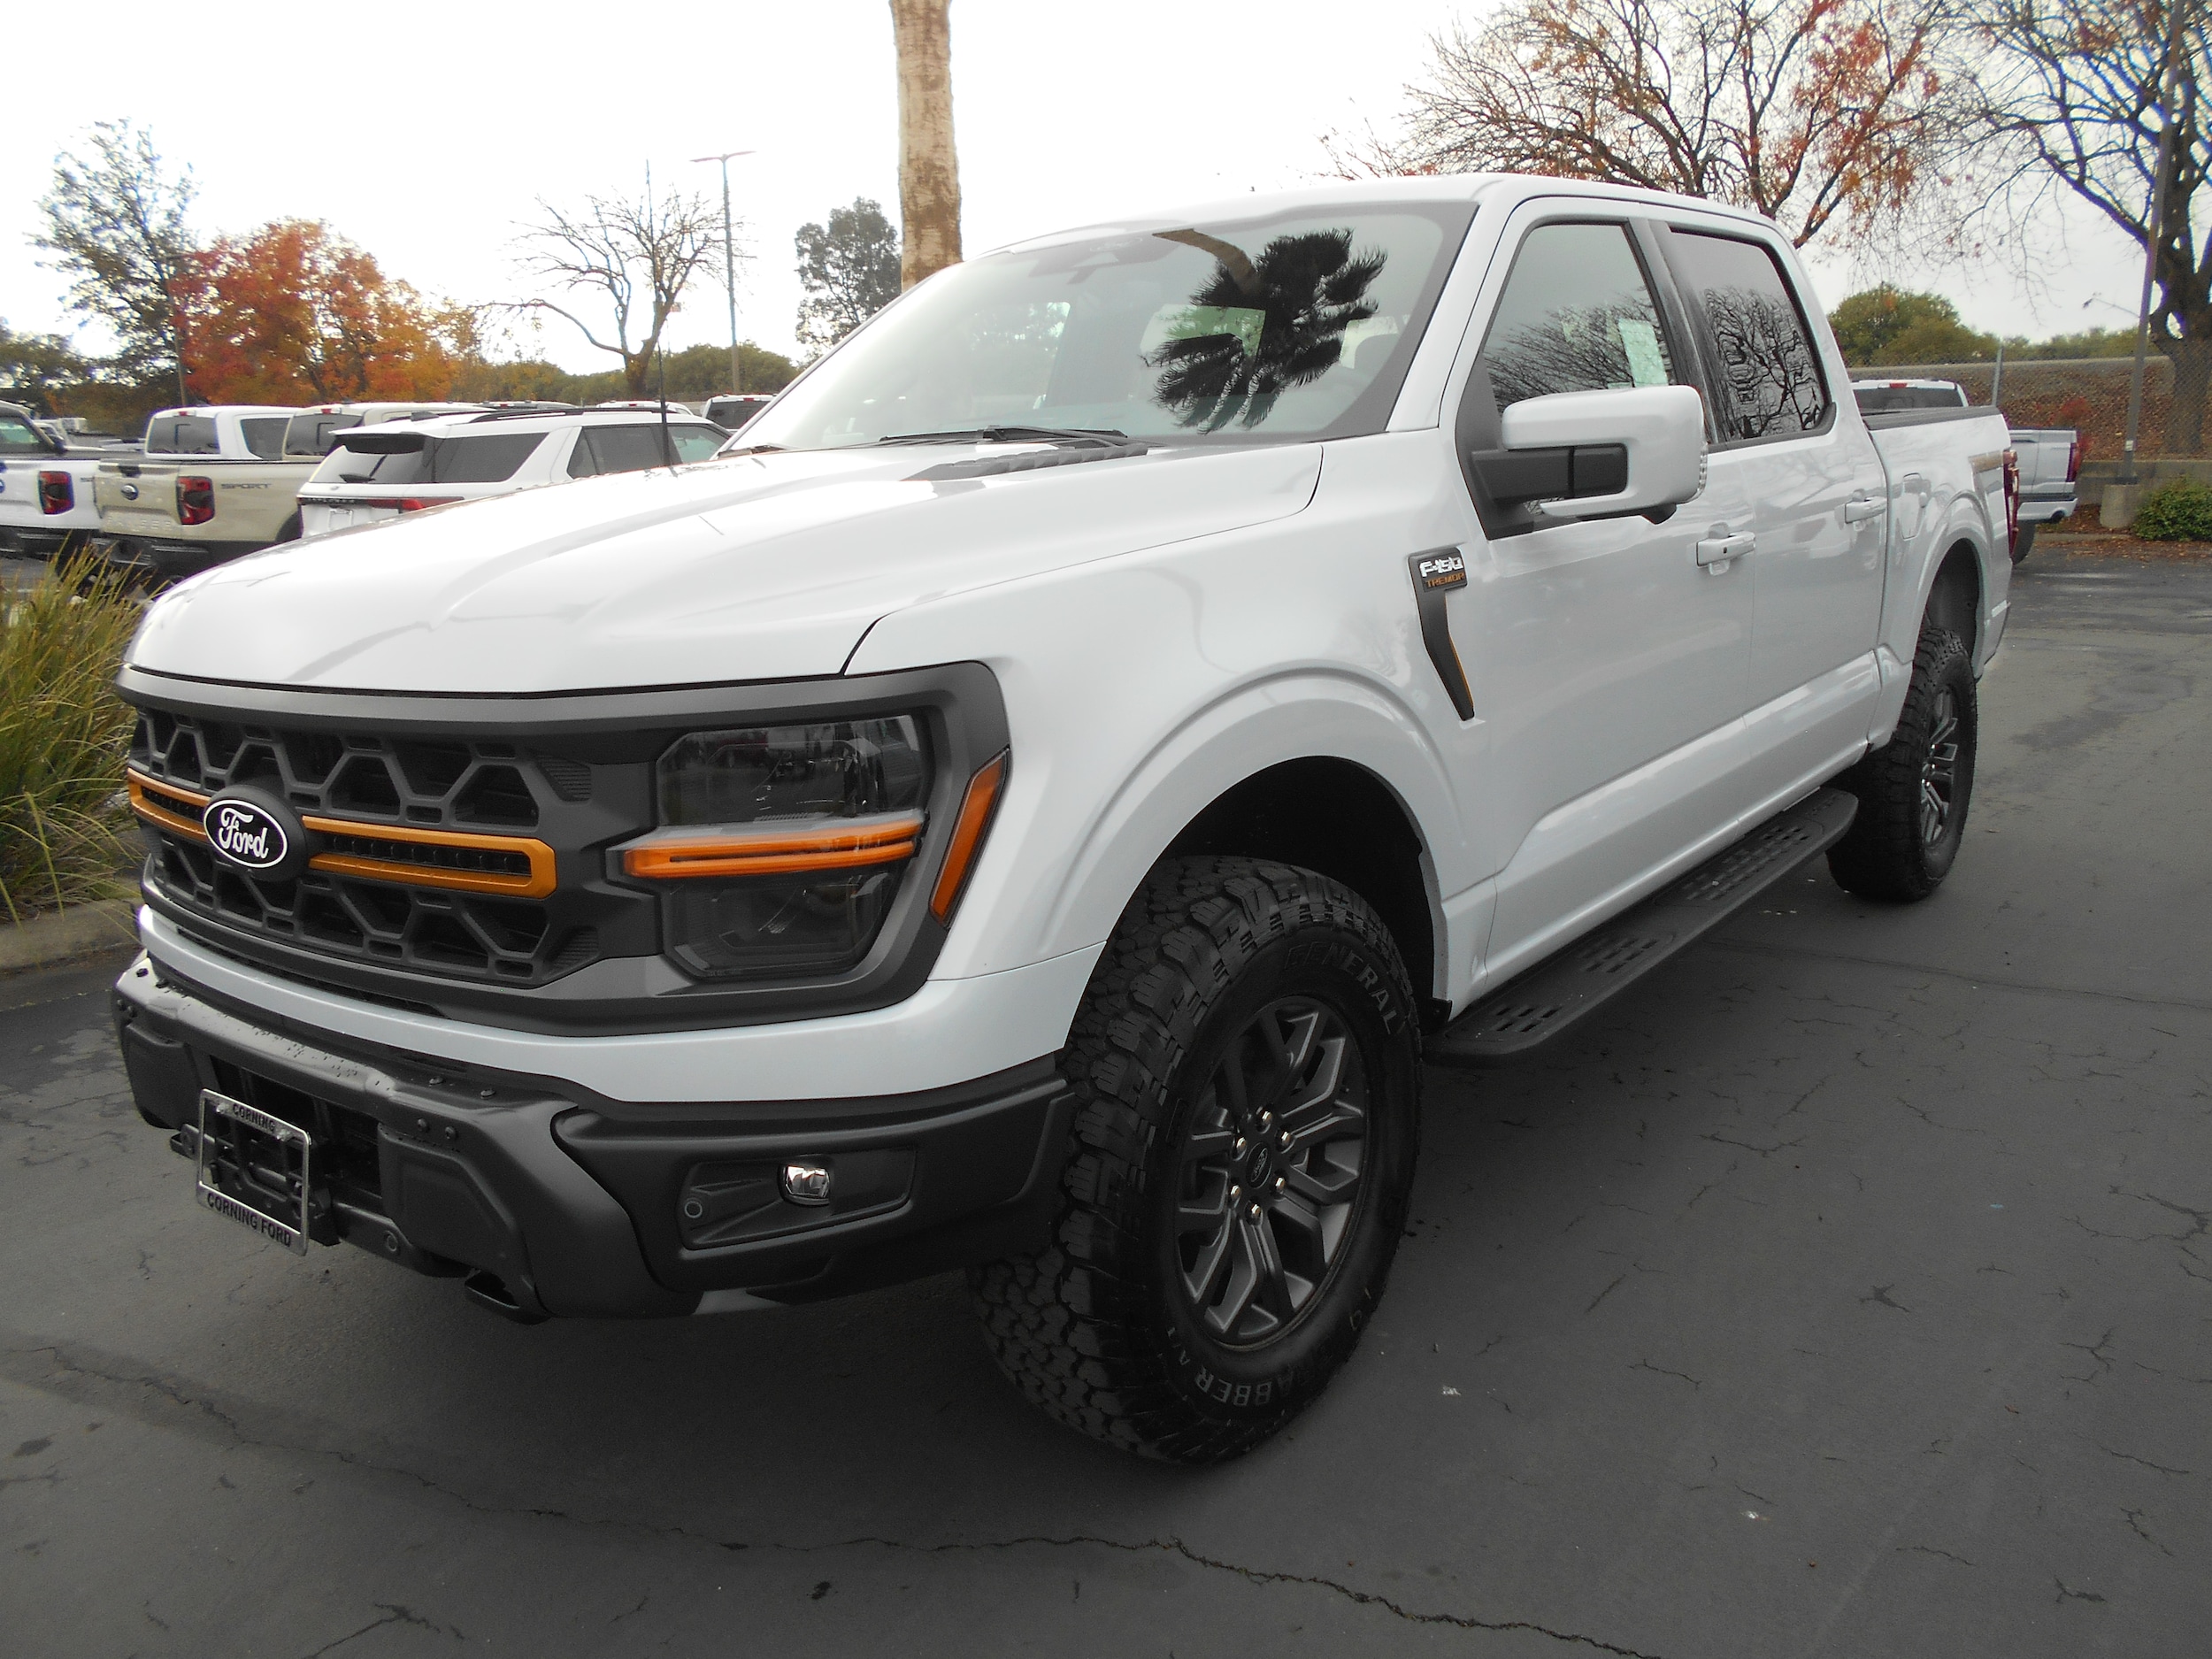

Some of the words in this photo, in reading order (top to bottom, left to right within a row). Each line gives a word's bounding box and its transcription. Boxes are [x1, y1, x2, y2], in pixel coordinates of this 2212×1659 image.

[1419, 557, 1464, 578] F-150
[1425, 573, 1464, 588] TREMOR
[218, 807, 269, 859] Ford
[232, 1103, 276, 1132] CORNING
[207, 1193, 257, 1230] CORNING
[261, 1217, 291, 1248] FORD
